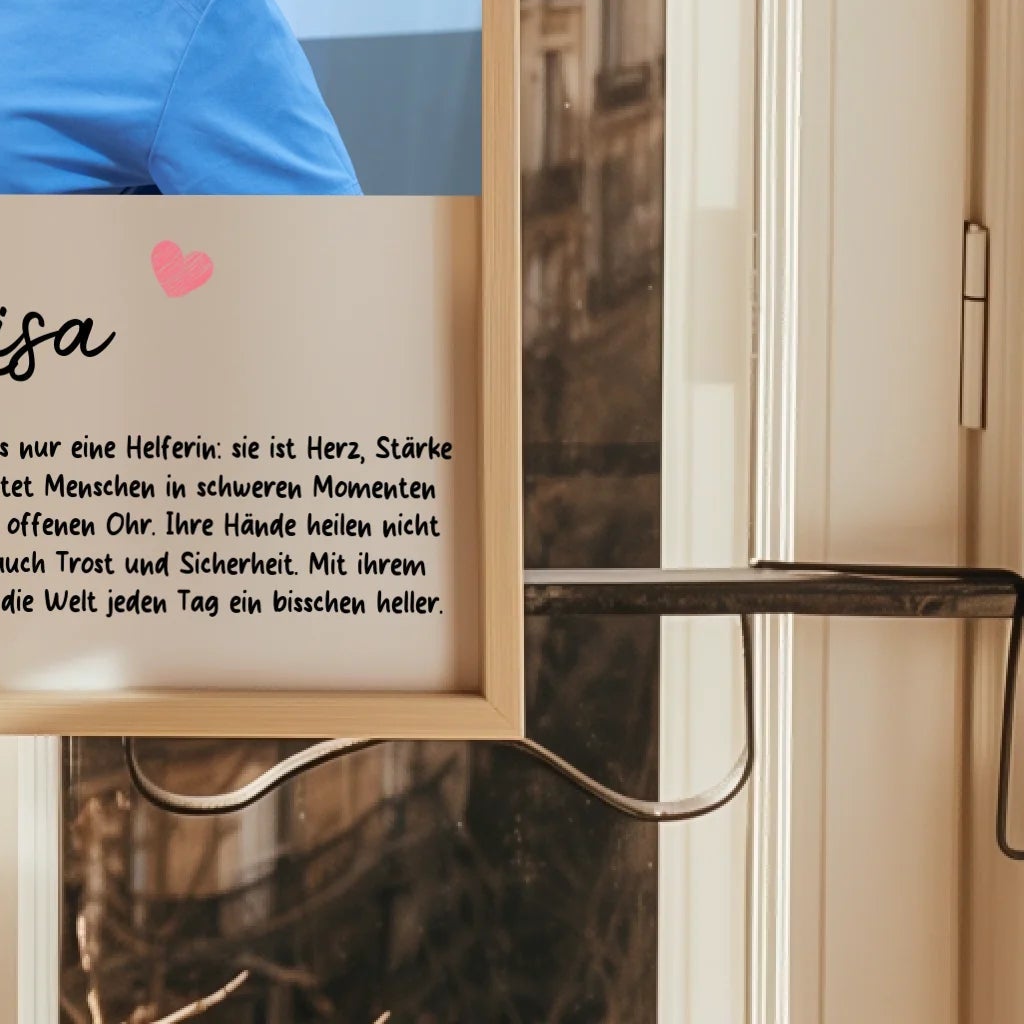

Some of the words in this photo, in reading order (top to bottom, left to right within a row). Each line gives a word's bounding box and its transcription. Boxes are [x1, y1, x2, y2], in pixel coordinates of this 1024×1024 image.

[19, 440, 62, 460] nur
[71, 434, 116, 460] eine
[126, 434, 222, 461] Helferin:
[231, 435, 260, 460] sie
[269, 435, 297, 460] ist
[307, 435, 366, 465] Herz,
[375, 435, 453, 461] Stärke
[44, 473, 156, 500] Menschen
[166, 473, 187, 500] in
[196, 474, 302, 500] schweren
[313, 474, 436, 501] Momenten
[7, 511, 96, 537] offenen
[106, 511, 156, 537] Ohr.
[165, 510, 214, 537] Ihre
[224, 512, 297, 539] Hände
[307, 512, 372, 538] heilen
[382, 512, 441, 539] nicht
[55, 550, 115, 575] Trost
[124, 551, 170, 577] und
[179, 550, 299, 576] Sicherheit.
[309, 551, 348, 576] Mit
[357, 551, 426, 577] ihrem
[1, 588, 34, 615] die
[44, 588, 98, 613] Welt
[105, 588, 167, 618] jeden
[176, 588, 219, 618] Tag
[229, 589, 262, 615] ein
[272, 589, 366, 616] bisschen
[376, 589, 444, 615] heller.
